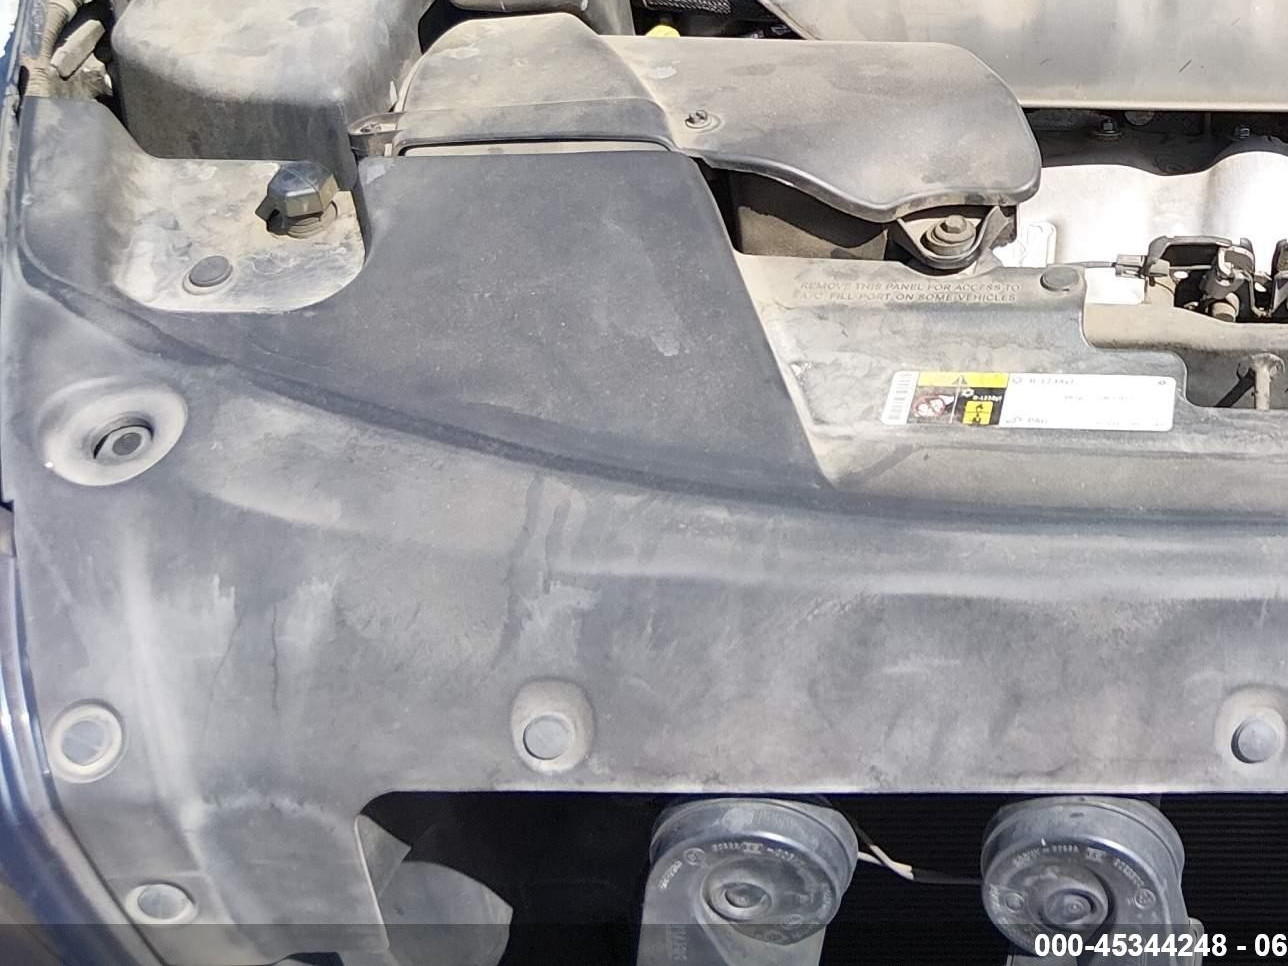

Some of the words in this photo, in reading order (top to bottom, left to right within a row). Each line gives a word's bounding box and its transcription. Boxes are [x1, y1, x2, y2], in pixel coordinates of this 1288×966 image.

[800, 281, 851, 290] REMOVE
[855, 282, 881, 290] THIS
[885, 282, 924, 291] PANEL
[927, 283, 951, 291] FOR
[954, 283, 1001, 292] ACCESS
[1005, 284, 1021, 292] TO
[830, 292, 854, 300] FILL
[859, 292, 891, 301] PORT
[895, 293, 914, 301] ON
[917, 293, 955, 302] SOME
[957, 293, 1017, 302] VEHICLES
